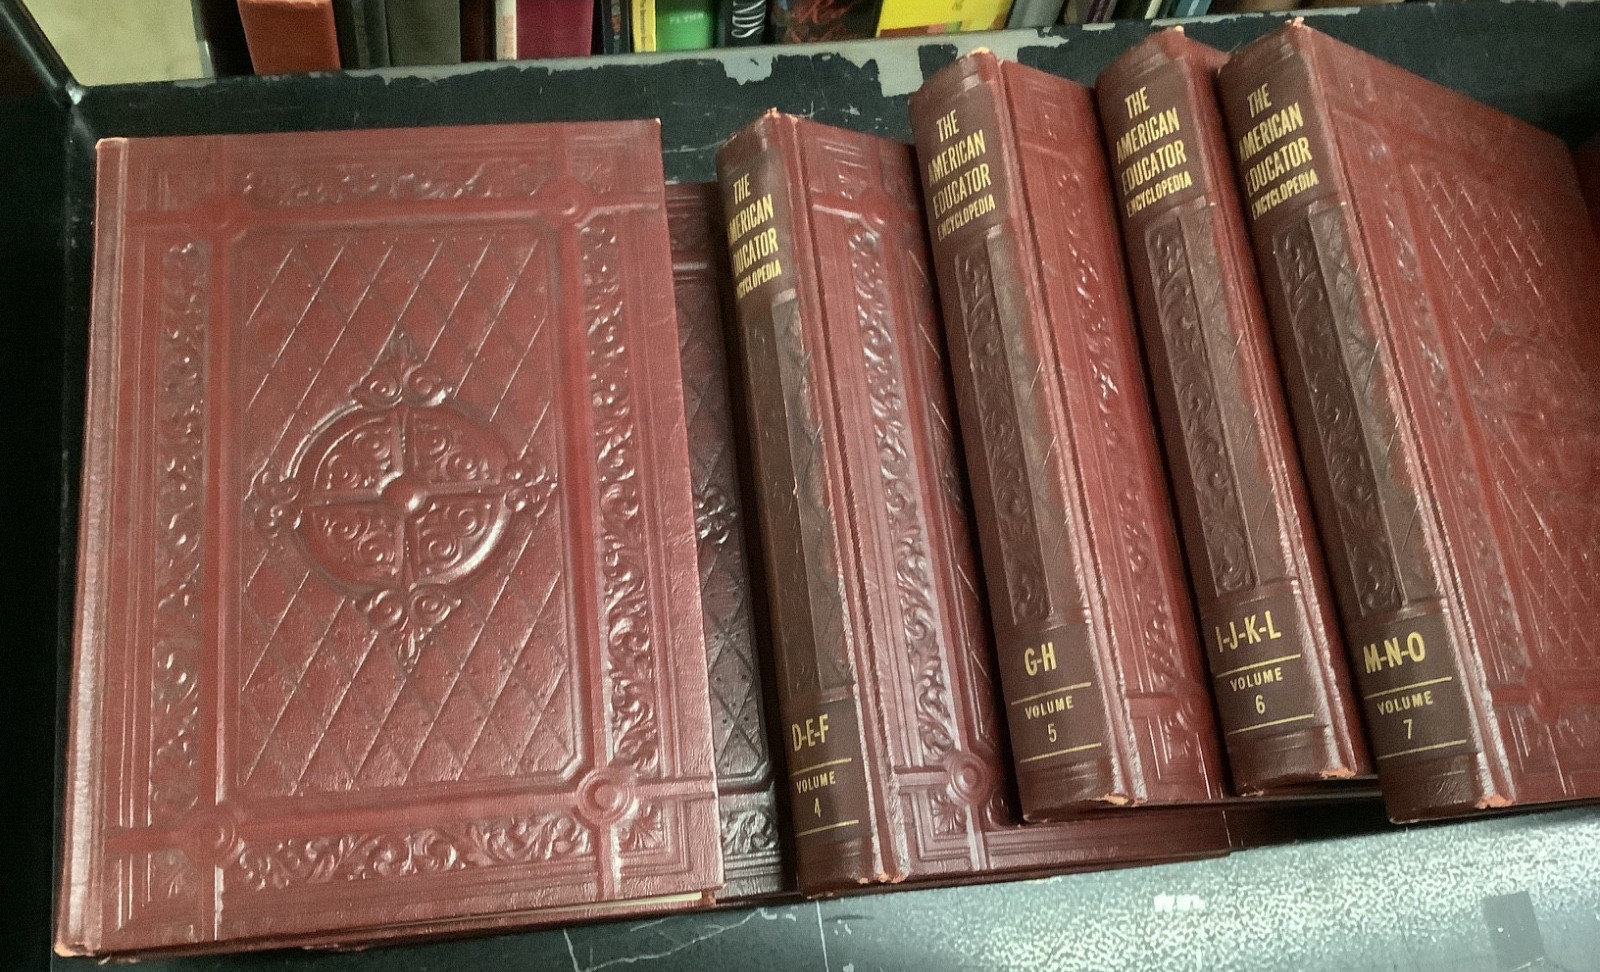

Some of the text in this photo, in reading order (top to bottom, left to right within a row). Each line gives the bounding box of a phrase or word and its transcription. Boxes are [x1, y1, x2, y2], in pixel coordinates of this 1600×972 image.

[1125, 87, 1150, 119] THE
[1246, 83, 1271, 118] THE
[936, 109, 959, 142] THE
[1116, 107, 1180, 164] AMERICAN
[1239, 102, 1303, 162] AMERICAN
[928, 129, 985, 187] AMERICAN
[1121, 140, 1187, 195] EDUCATOR
[1245, 137, 1312, 197] EDUCATOR
[733, 173, 751, 204] THE
[932, 163, 991, 219] EDUCATOR
[727, 193, 774, 245] MERICAN
[733, 228, 778, 277] DUCATOR
[1215, 610, 1281, 653] I-J-K-L
[1024, 642, 1057, 676] G-H
[1363, 631, 1425, 674] M-N-O
[1230, 667, 1283, 692] VOLUME
[1025, 695, 1074, 720] VOLUME
[1255, 694, 1266, 715] 6
[1376, 690, 1433, 716] VOLUME
[792, 713, 829, 752] D-E-F
[1047, 722, 1057, 743] 5
[1403, 719, 1413, 740] 7
[796, 770, 836, 794] VOLUME
[814, 797, 822, 818] 4
